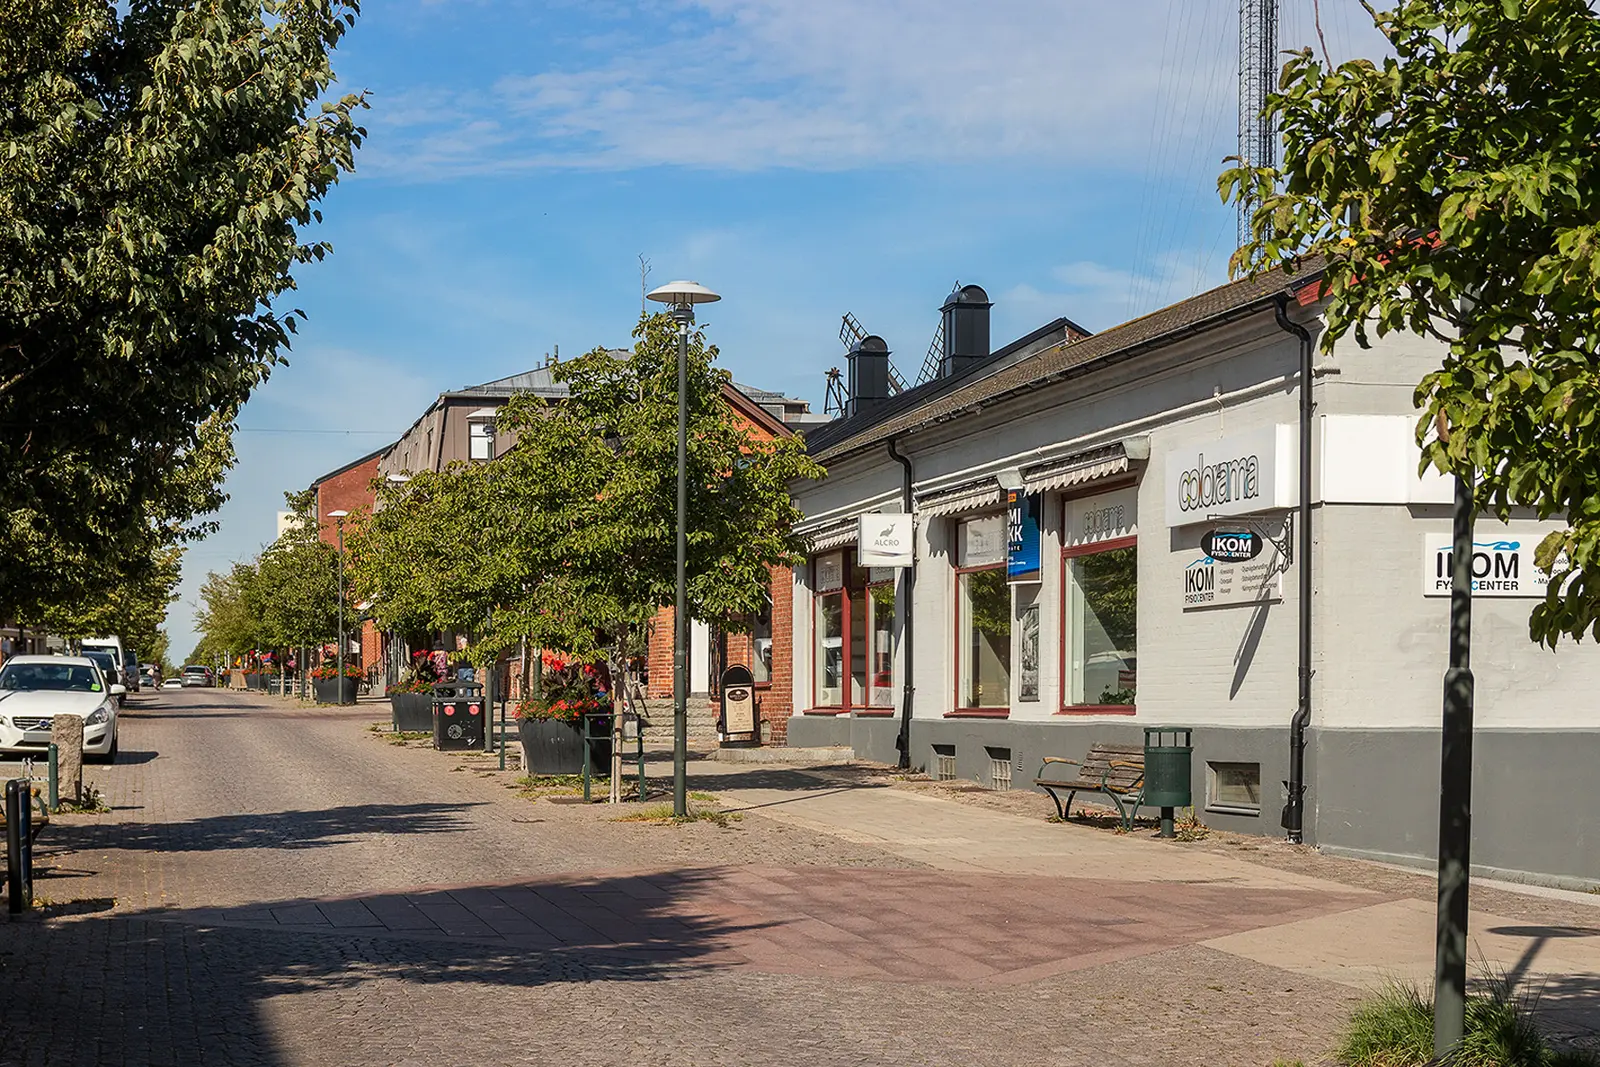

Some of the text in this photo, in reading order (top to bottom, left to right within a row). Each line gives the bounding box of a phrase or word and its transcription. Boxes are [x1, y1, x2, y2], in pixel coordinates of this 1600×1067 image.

[1178, 453, 1259, 512] colorama
[1008, 507, 1021, 525] MI
[1211, 537, 1252, 551] IKOM
[1185, 566, 1215, 593] IKOM
[1436, 580, 1518, 590] FYCENTER
